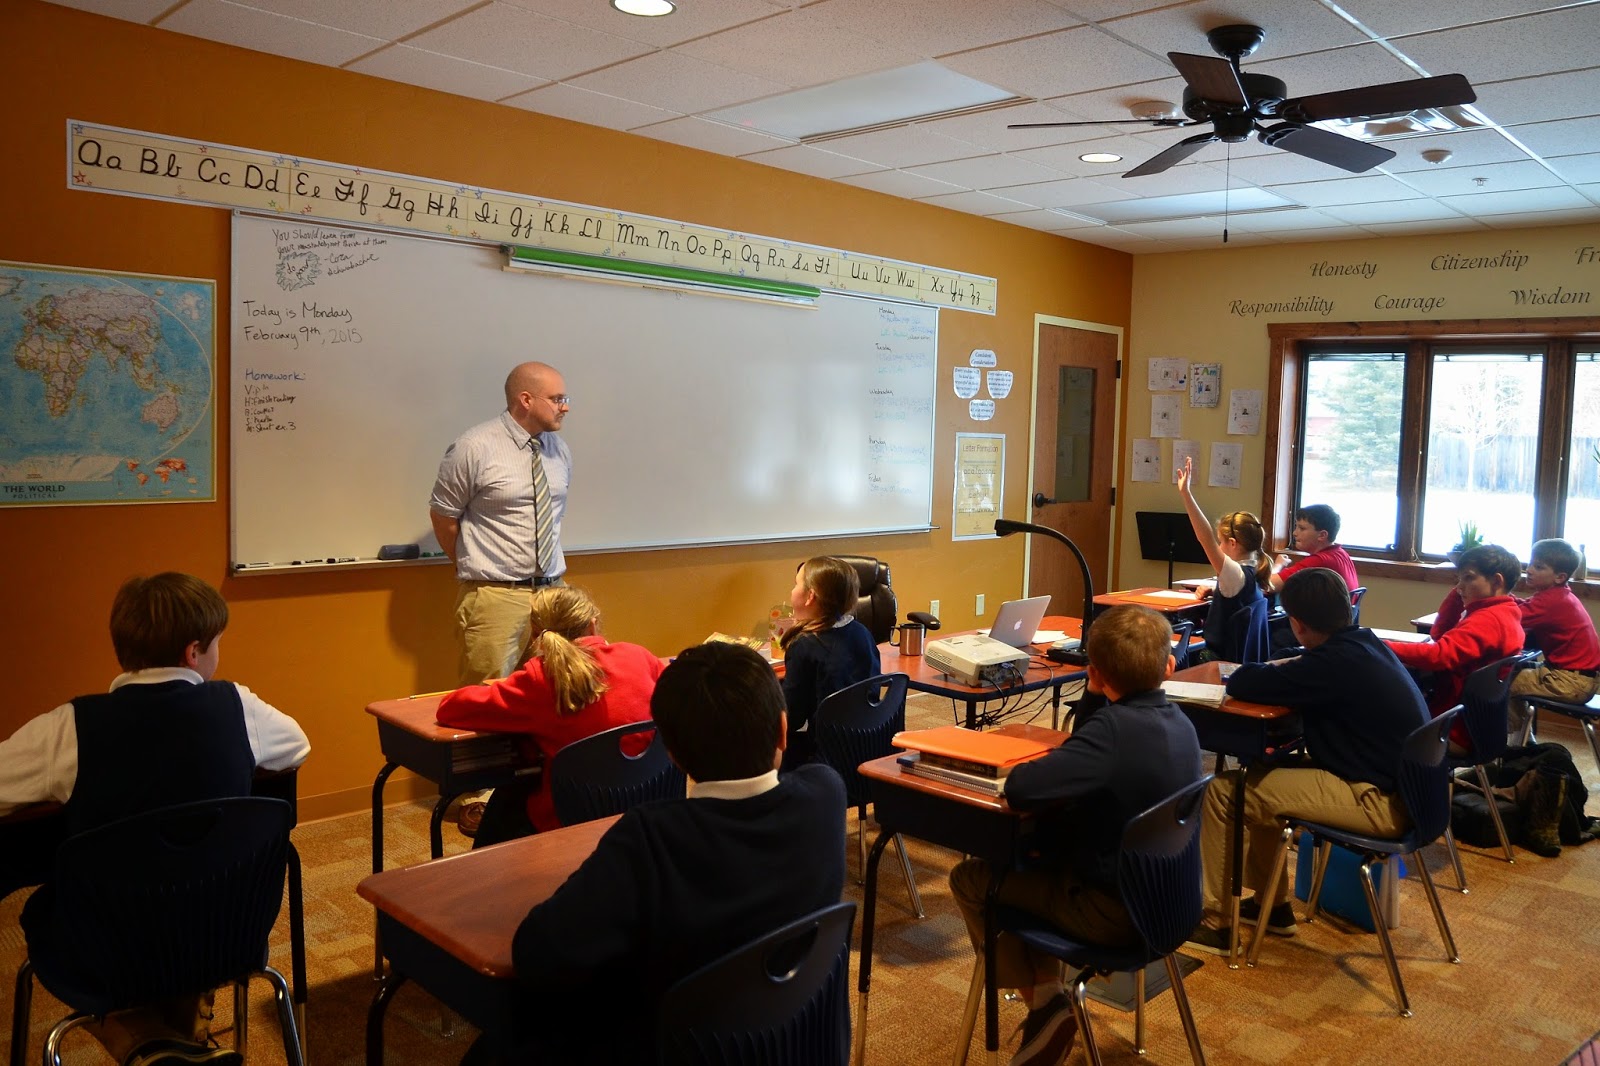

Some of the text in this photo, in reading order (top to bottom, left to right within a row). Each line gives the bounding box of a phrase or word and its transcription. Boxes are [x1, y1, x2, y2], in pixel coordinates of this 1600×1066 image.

[1309, 260, 1379, 280] Honesty
[1430, 249, 1530, 272] Citizenship
[1374, 294, 1447, 313] Courage
[1508, 286, 1591, 306] Wisdom
[242, 301, 352, 326] Today is Monday
[1228, 296, 1336, 318] Responsibility
[244, 325, 299, 351] February
[328, 328, 363, 345] 2015
[3, 484, 66, 493] THE WORLD
